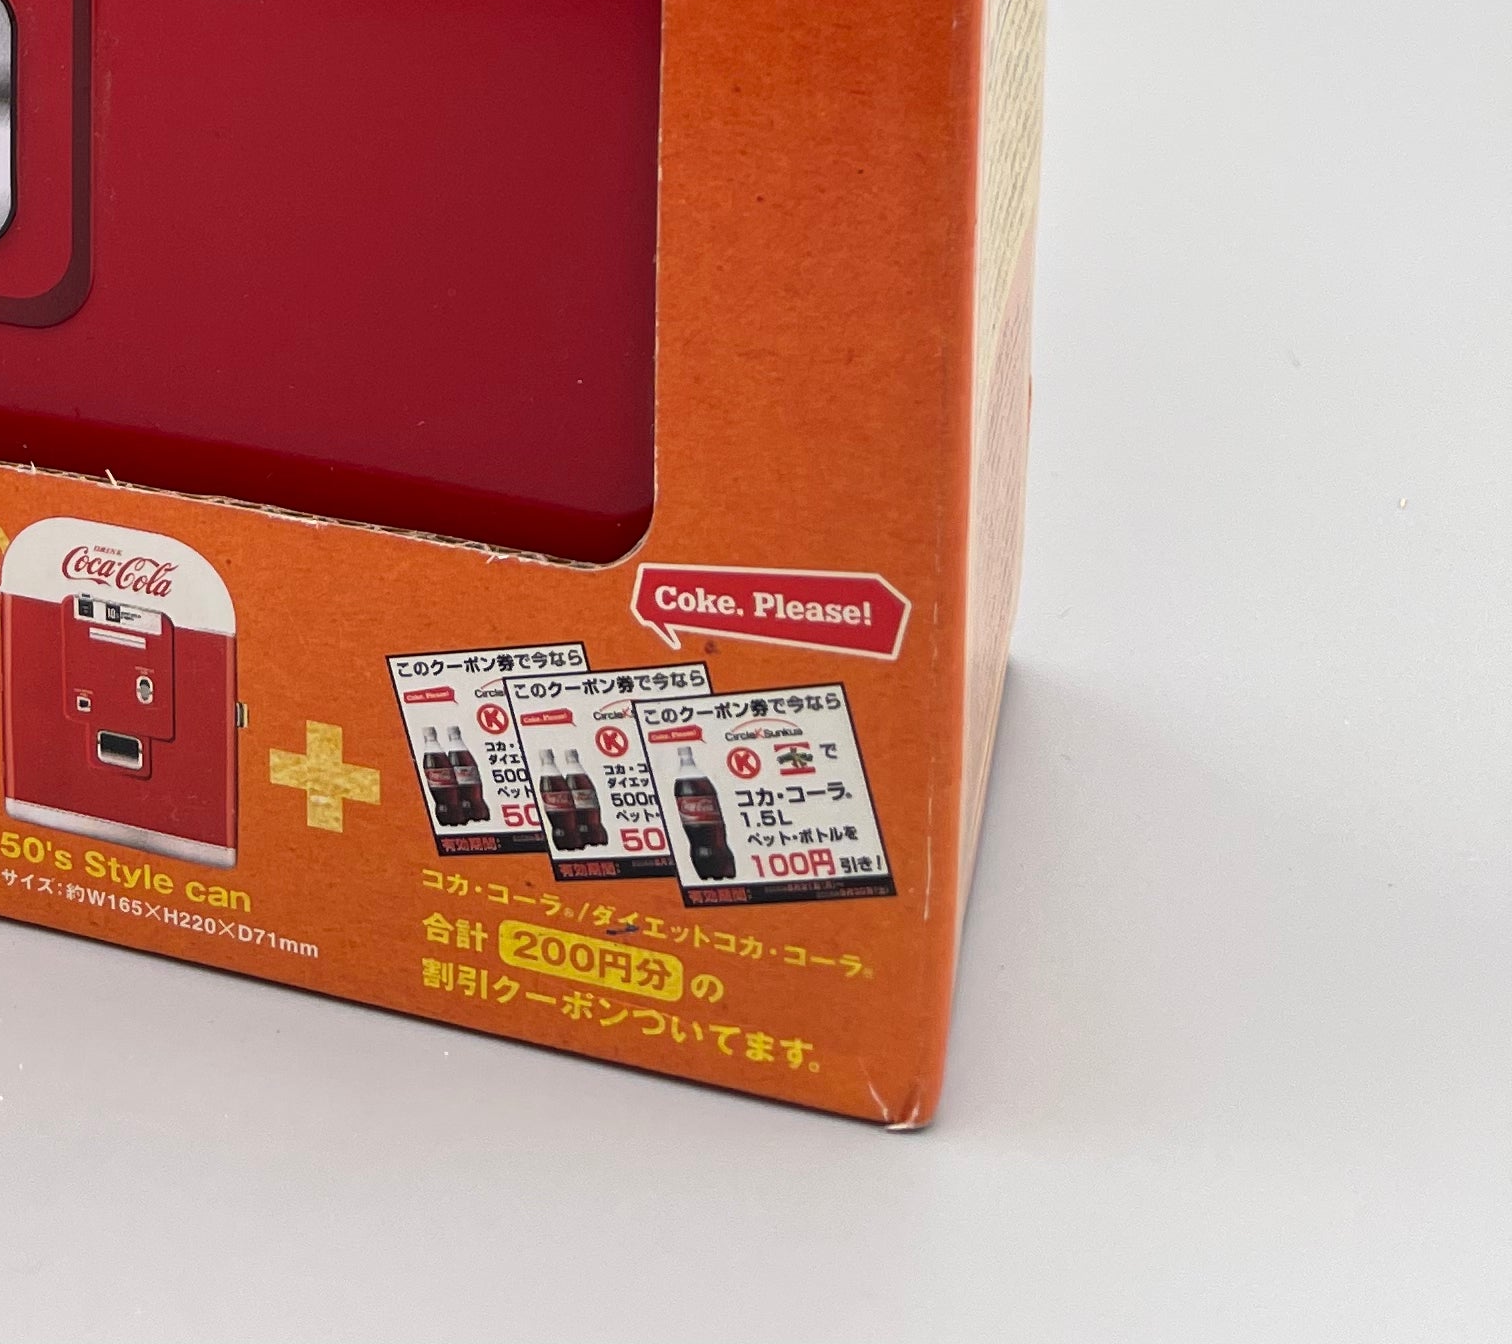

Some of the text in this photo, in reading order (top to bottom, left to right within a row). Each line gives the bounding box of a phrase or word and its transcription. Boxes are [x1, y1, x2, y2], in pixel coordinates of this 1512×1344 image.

[61, 546, 179, 598] Coca-Cola
[753, 591, 873, 626] Please!
[396, 650, 583, 678] このクーポン券で今なら
[514, 670, 706, 700] このクーポン券で今なら
[643, 693, 842, 726] このクーポン券で今なら
[819, 742, 839, 760] で
[739, 809, 793, 828] 1.5L
[620, 827, 667, 852] 50
[0, 831, 252, 913] 50's Style can
[750, 848, 837, 878] 100円
[422, 913, 726, 1004] 合計 200円分 の
[421, 957, 821, 1074] 割引クーポンついてます。
